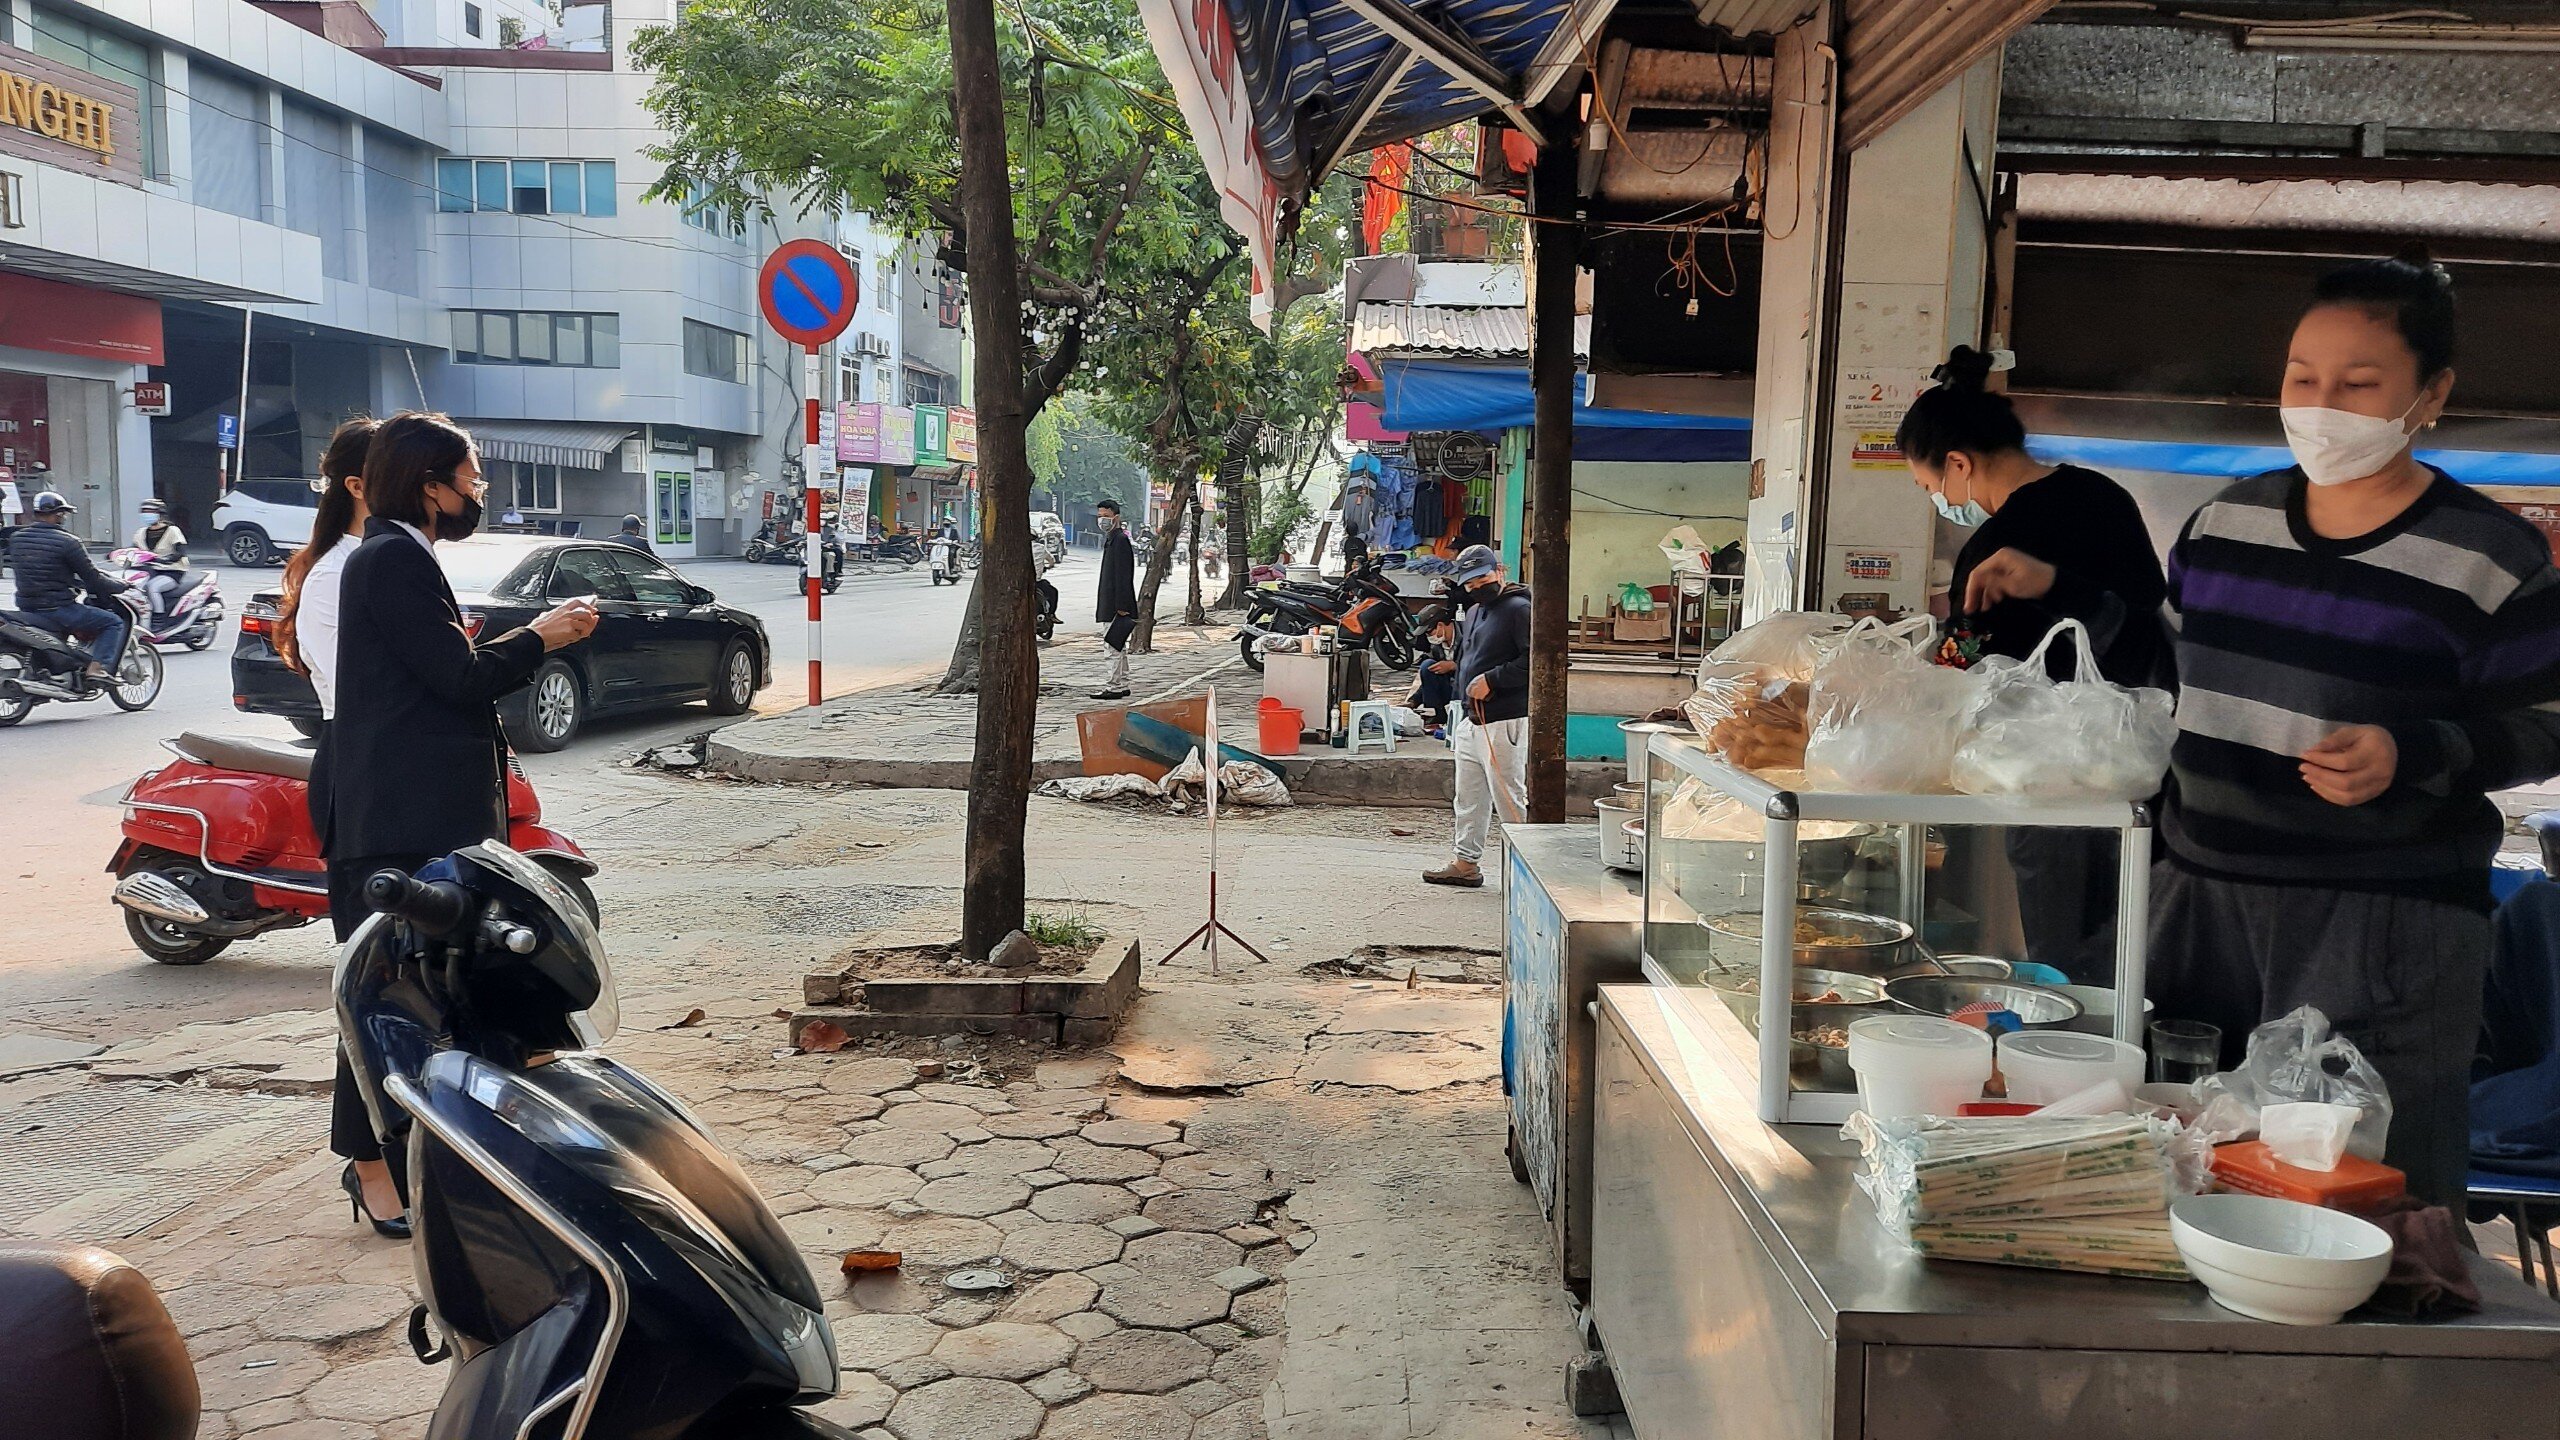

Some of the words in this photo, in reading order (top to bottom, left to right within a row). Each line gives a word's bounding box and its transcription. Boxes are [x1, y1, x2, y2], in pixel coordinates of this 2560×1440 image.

[136, 389, 163, 400] ATM
[224, 418, 232, 433] P
[840, 425, 858, 434] HOA
